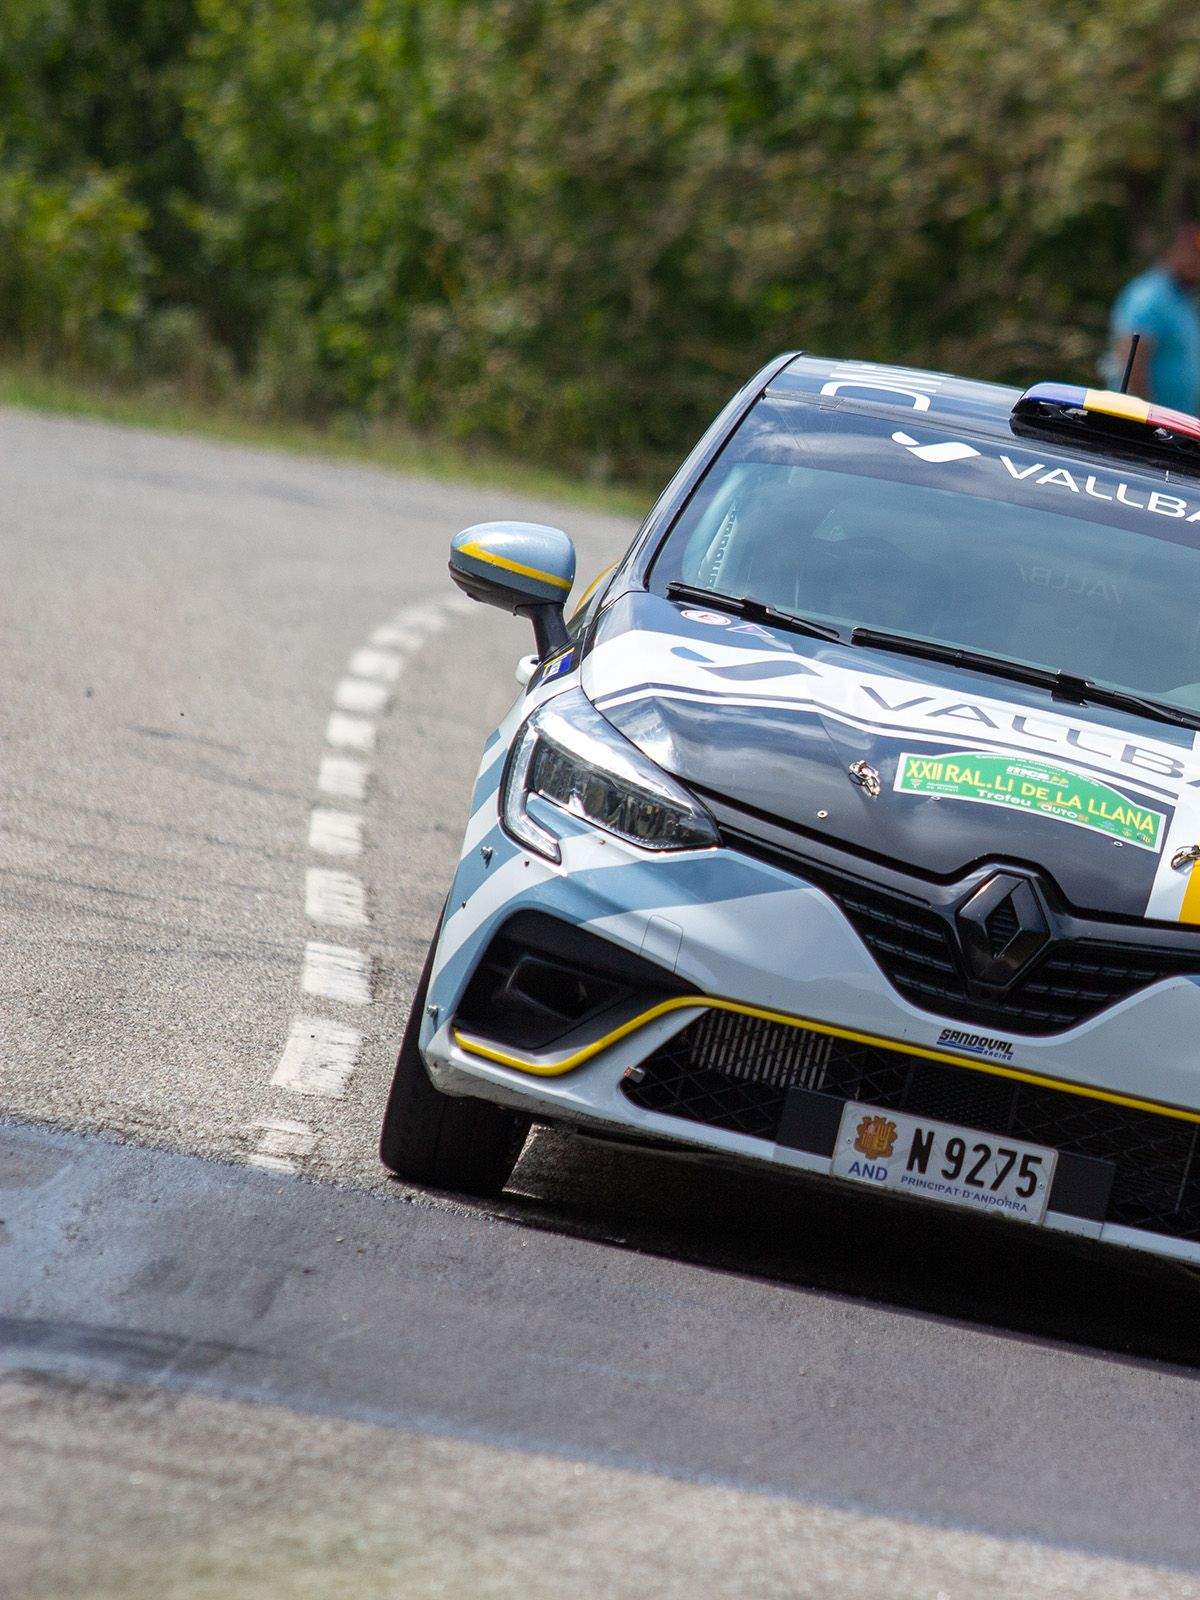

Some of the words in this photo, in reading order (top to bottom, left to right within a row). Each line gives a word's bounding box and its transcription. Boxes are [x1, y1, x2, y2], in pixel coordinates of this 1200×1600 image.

[906, 759, 943, 781] XXII
[944, 763, 1015, 792] RAL.LI
[1021, 782, 1050, 801] DE
[1056, 791, 1082, 810] LA
[1088, 798, 1155, 835] LLANA
[976, 788, 1032, 807] Trofeu
[938, 1028, 1014, 1056] SANDOVAL
[983, 1050, 1012, 1061] RACING
[848, 1161, 889, 1182] AND
[906, 1127, 935, 1175] N
[940, 1137, 1043, 1199] 9275
[900, 1175, 960, 1196] PRINCIPAT
[962, 1190, 1028, 1213] D'ANDORRA
